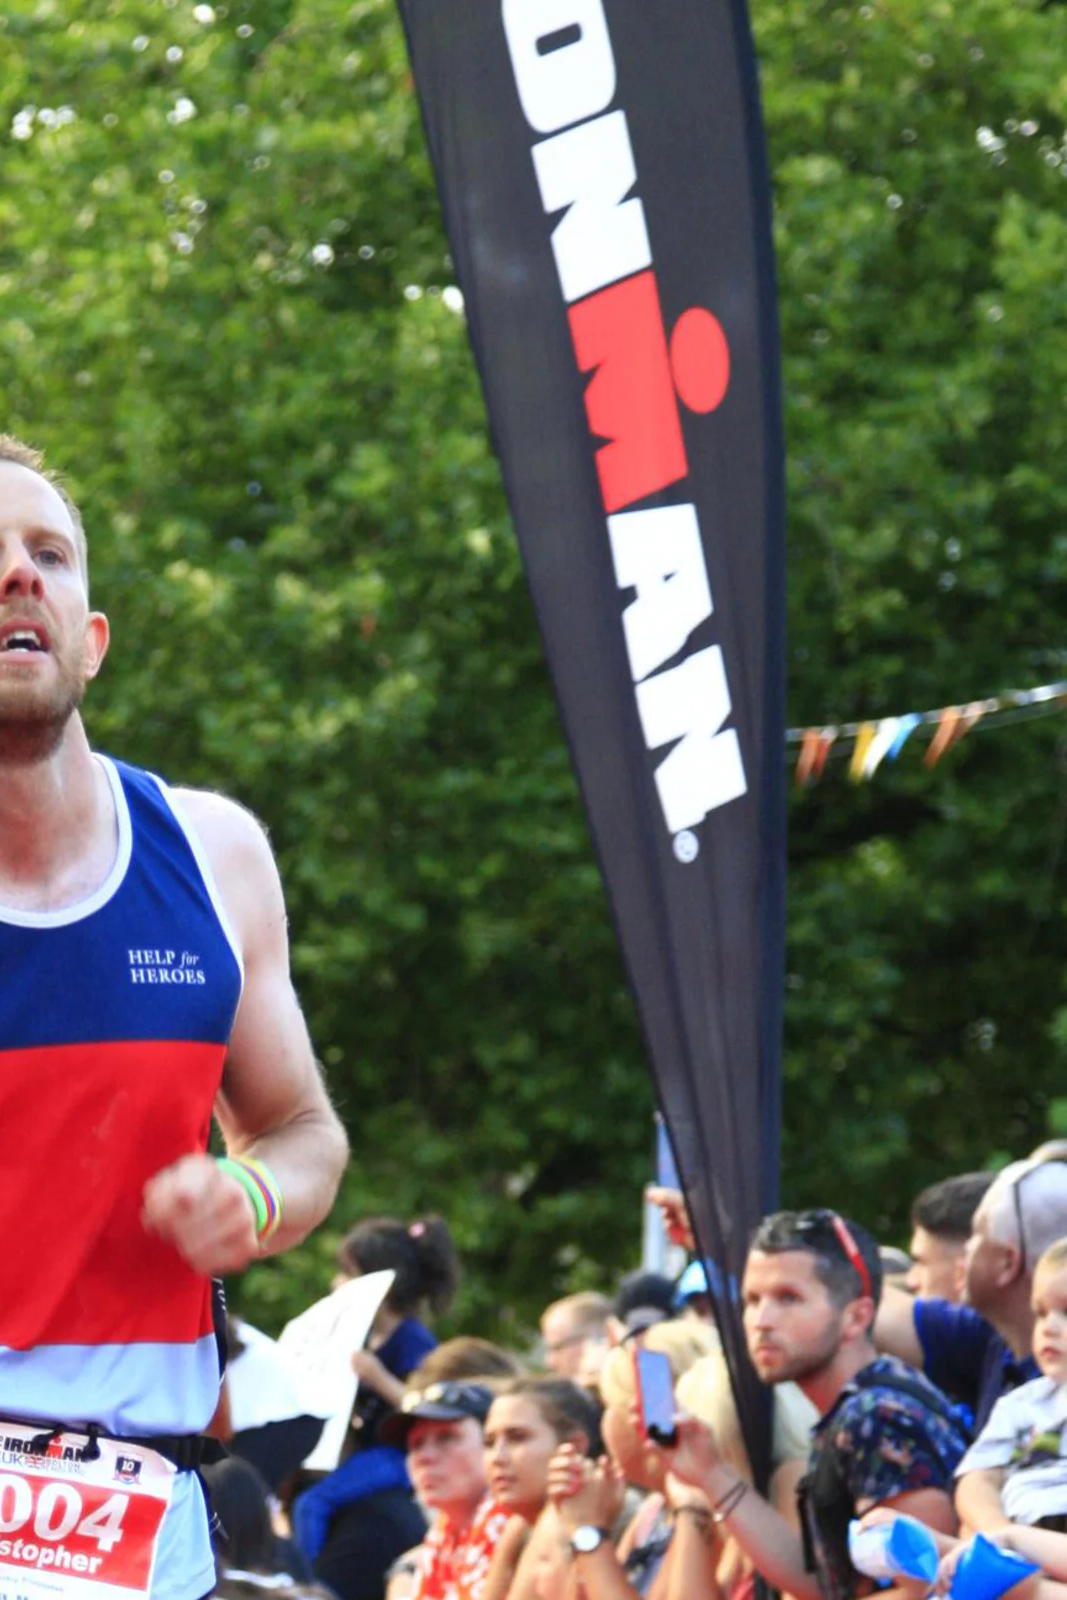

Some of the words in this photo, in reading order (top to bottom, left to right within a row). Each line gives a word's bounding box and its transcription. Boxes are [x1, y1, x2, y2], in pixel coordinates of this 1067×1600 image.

[128, 949, 176, 966] HELP
[180, 951, 199, 968] for
[130, 967, 206, 985] HEROES
